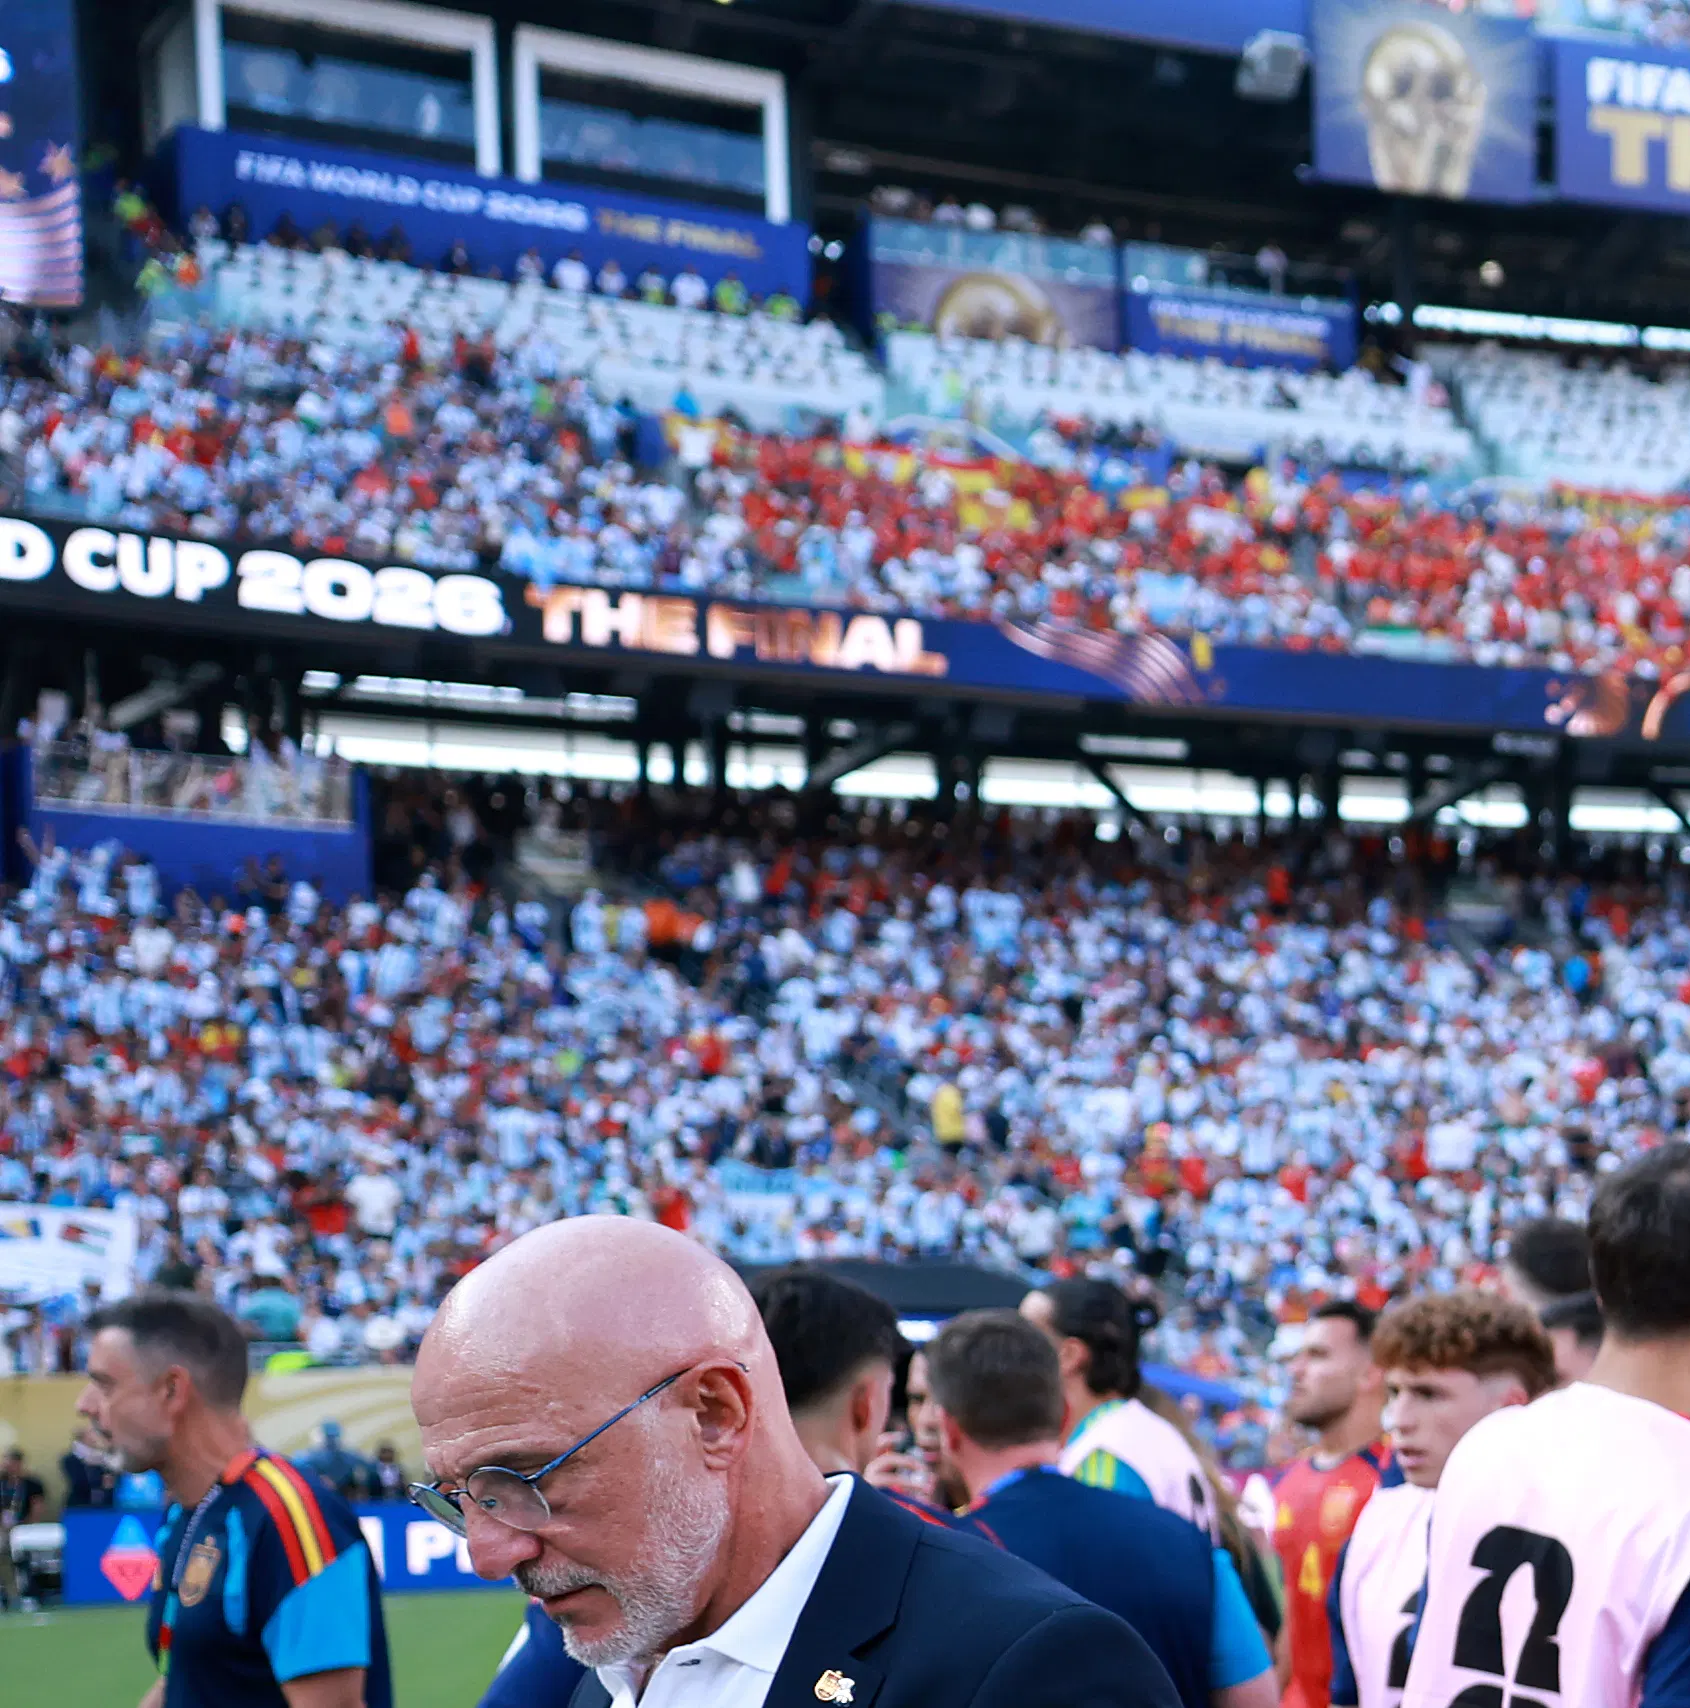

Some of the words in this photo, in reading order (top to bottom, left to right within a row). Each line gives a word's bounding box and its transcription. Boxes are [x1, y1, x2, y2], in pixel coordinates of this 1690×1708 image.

[237, 150, 305, 187] FIFA
[307, 161, 420, 204] WORLD
[423, 180, 482, 213] CUP
[484, 189, 589, 232] 2026
[597, 207, 662, 243] THE
[664, 216, 762, 260] FINAL
[63, 526, 230, 602] CUP
[237, 550, 506, 636] 2026
[525, 583, 698, 656] THE
[706, 602, 948, 678] FINAL
